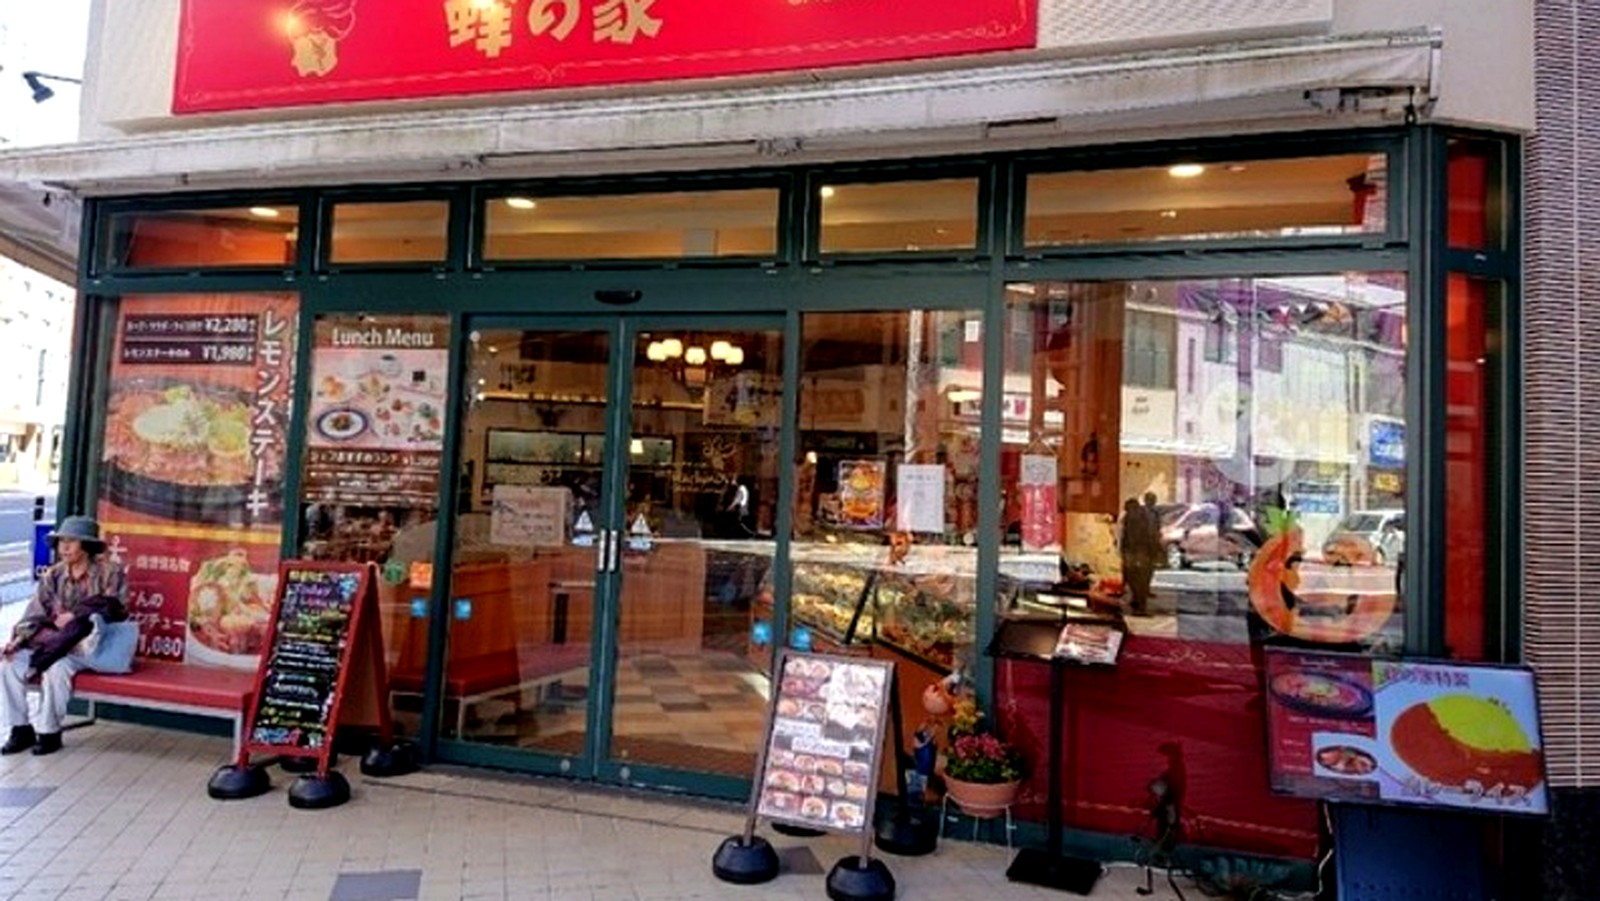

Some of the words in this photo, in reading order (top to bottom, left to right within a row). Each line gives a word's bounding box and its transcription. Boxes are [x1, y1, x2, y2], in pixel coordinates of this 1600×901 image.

[445, 0, 664, 58] 蜂の家
[332, 327, 383, 346] Lunch
[385, 328, 434, 347] Menu
[245, 310, 286, 516] レモンステーキ
